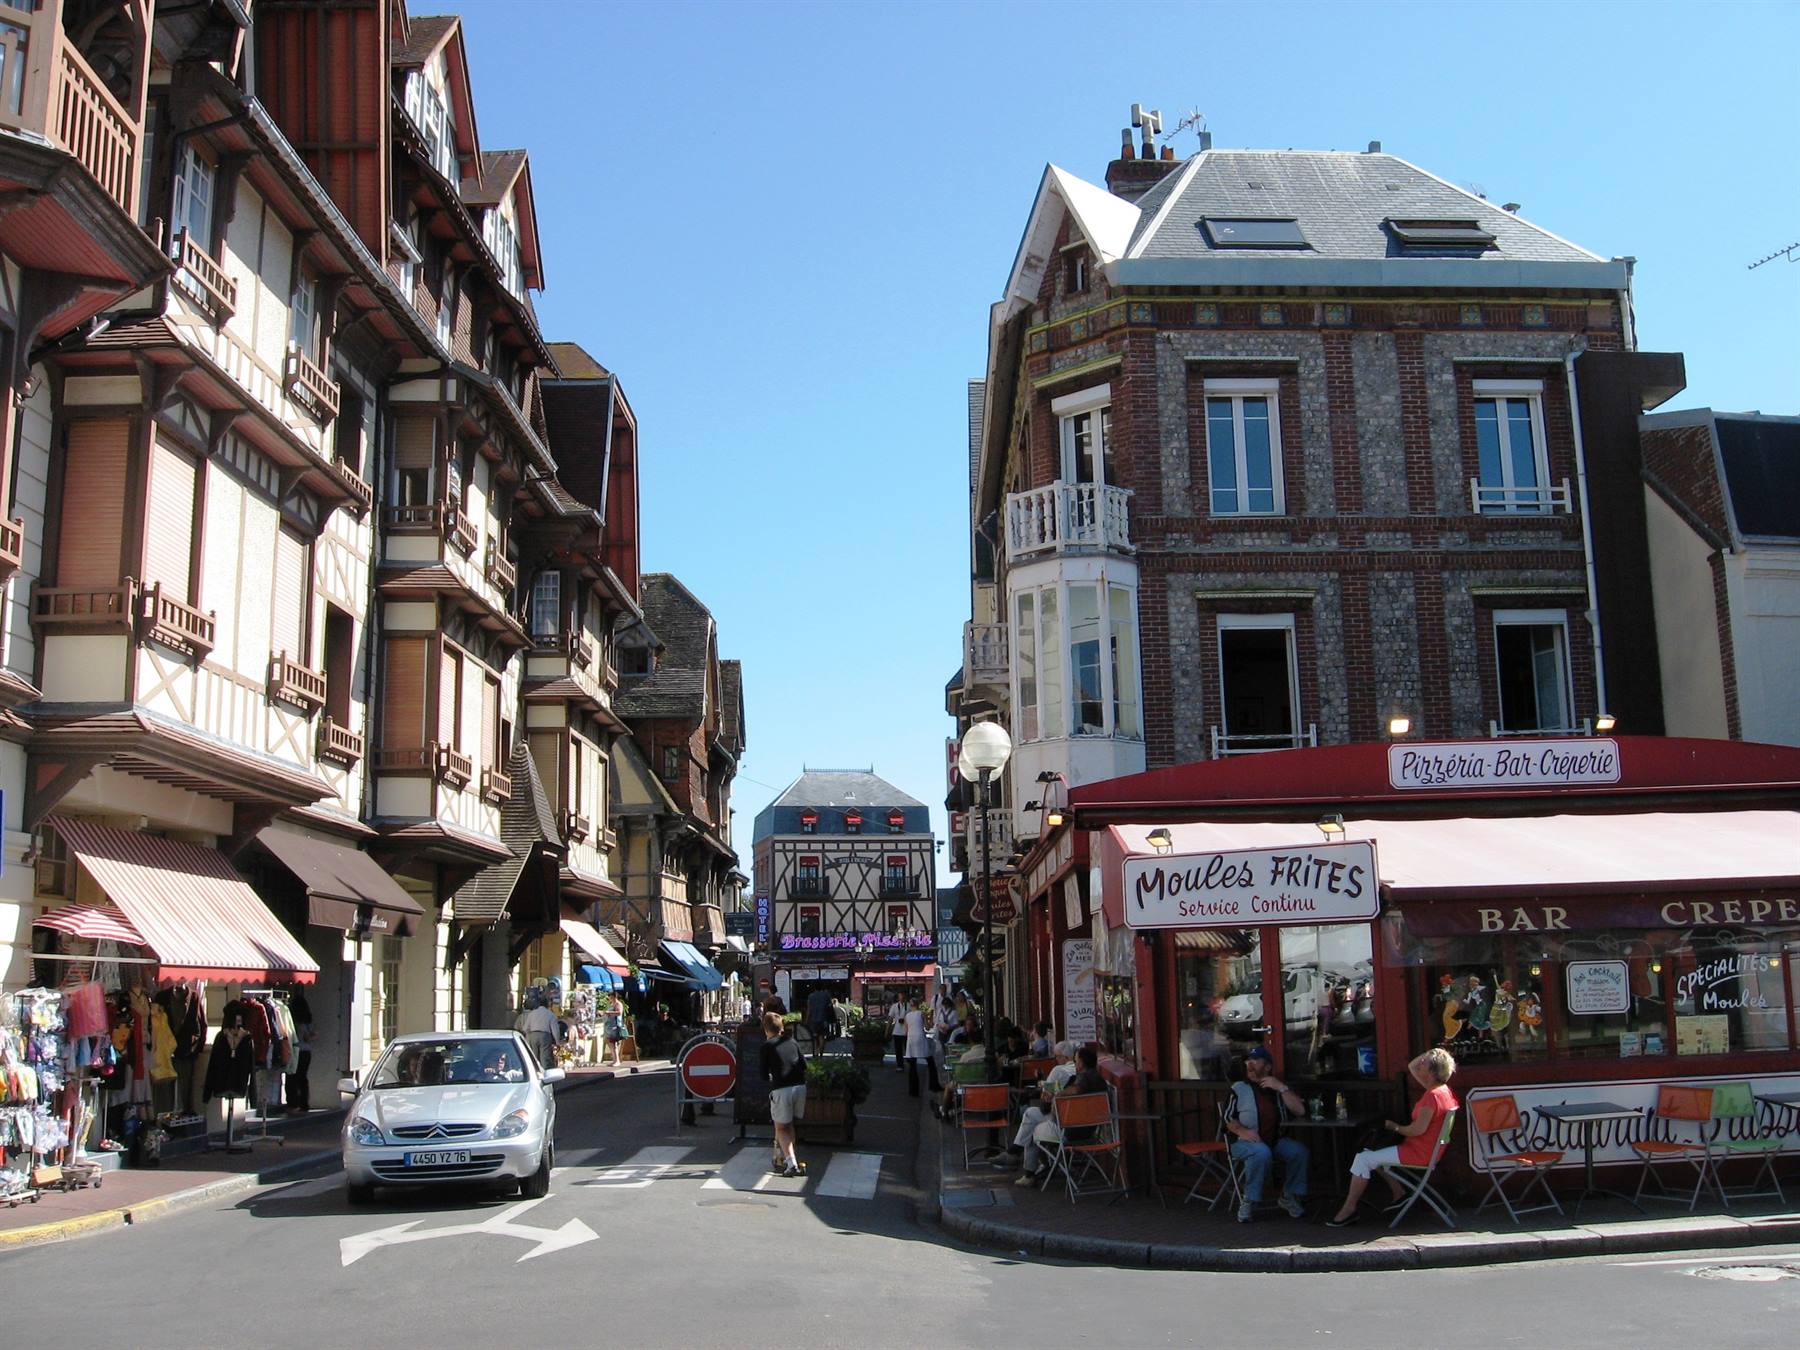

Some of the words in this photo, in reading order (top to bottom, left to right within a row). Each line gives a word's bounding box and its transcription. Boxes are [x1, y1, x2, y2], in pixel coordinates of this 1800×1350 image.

[1402, 751, 1484, 784] Pizzéria
[1493, 749, 1532, 777] Bar
[1136, 855, 1254, 909] Moules
[1179, 898, 1240, 917] Service
[1251, 893, 1317, 913] Continu
[758, 898, 768, 942] HOTEL
[1478, 907, 1571, 932] BAR
[782, 932, 857, 949] Brasserie
[862, 931, 932, 948] Pizzia
[1703, 988, 1769, 1010] Moules
[413, 1153, 437, 1165] 4450
[440, 1152, 451, 1163] YZ
[454, 1151, 466, 1163] 76
